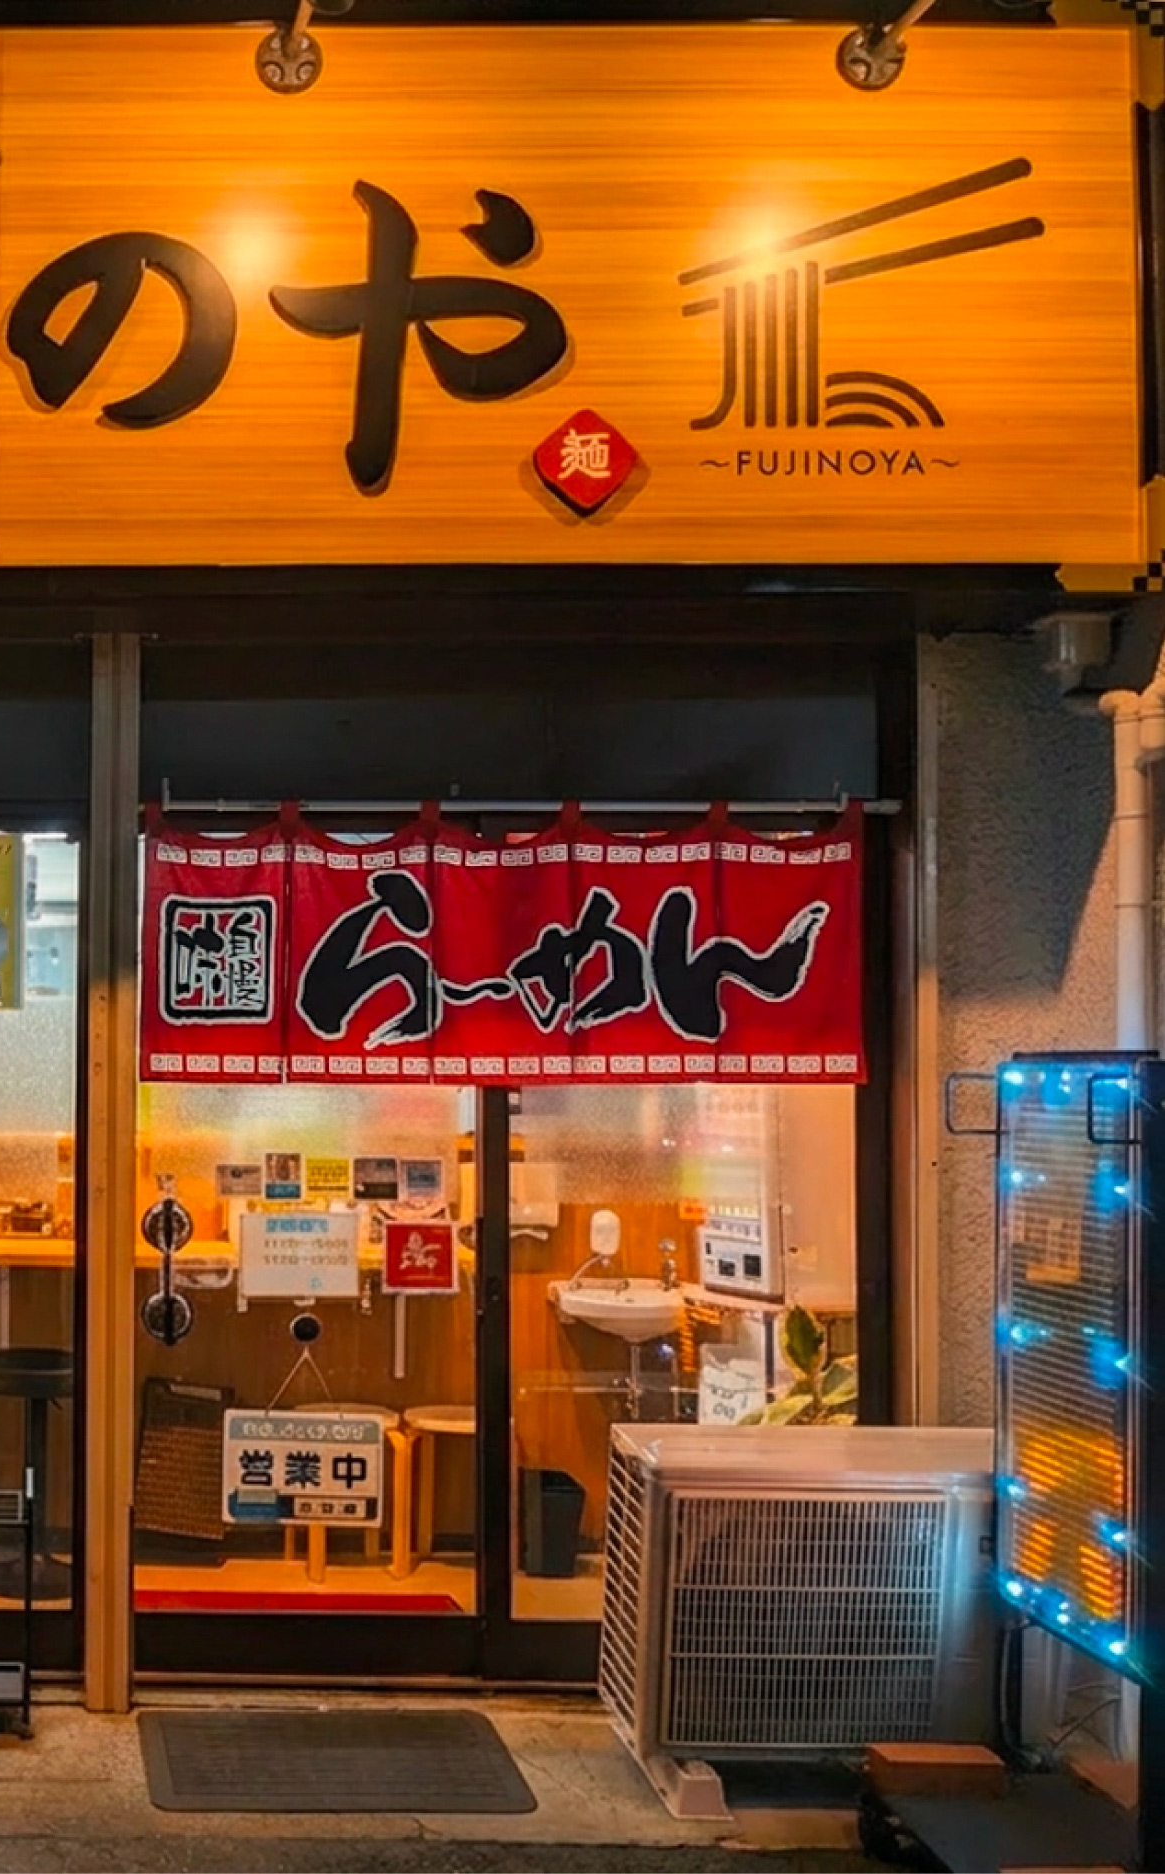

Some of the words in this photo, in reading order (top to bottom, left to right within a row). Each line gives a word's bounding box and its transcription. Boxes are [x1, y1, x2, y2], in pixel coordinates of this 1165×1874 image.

[297, 869, 830, 1051] らーめん
[239, 1449, 367, 1489] 営業中
